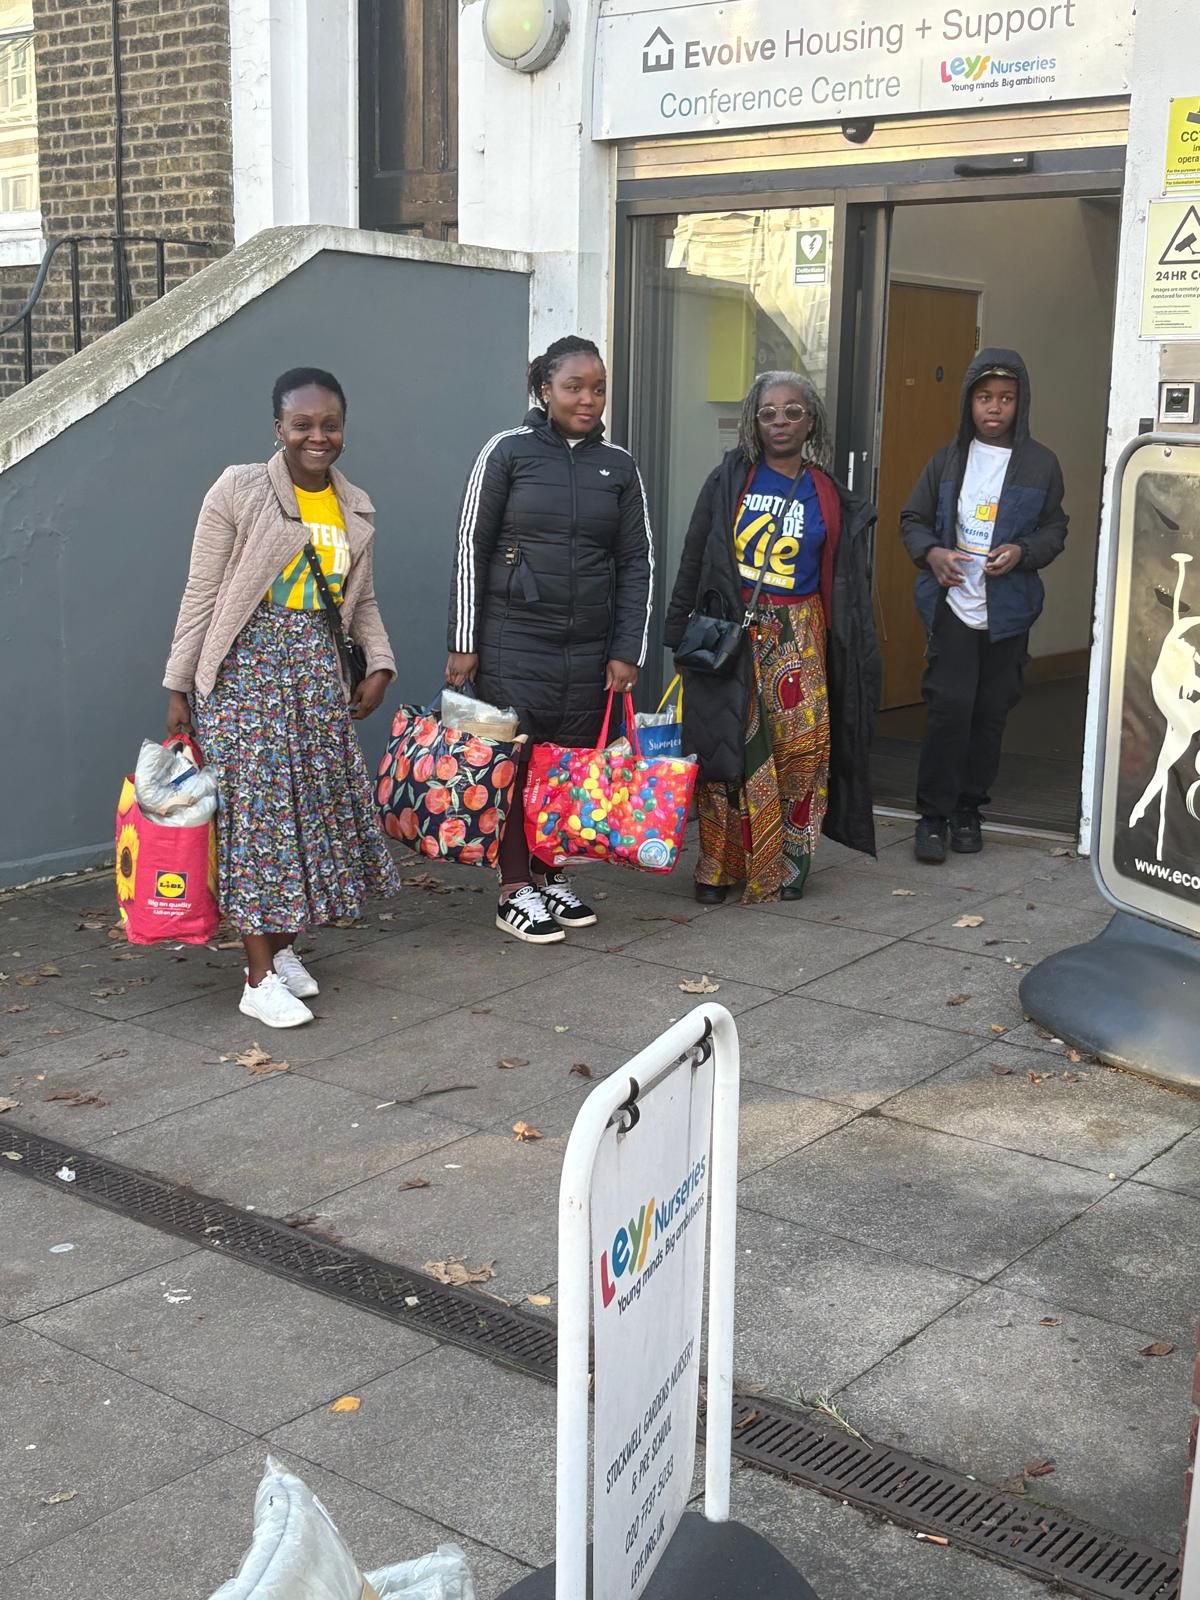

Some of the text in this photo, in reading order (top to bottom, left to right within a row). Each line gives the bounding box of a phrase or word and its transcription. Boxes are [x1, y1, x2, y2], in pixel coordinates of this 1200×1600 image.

[684, 0, 1076, 69] Evolve Housing + Support
[951, 75, 1056, 92] Young minds Big ambitions
[990, 57, 1057, 75] Nurseries
[660, 74, 901, 119] Conference Centre
[1180, 130, 1200, 142] CC
[1190, 269, 1200, 281] C
[733, 504, 800, 576] Vie
[781, 515, 804, 538] DE
[654, 1153, 706, 1241] Nurseries
[617, 1191, 705, 1316] Young minds Big ambitions
[606, 1335, 695, 1495] STOCKWELL GARDENS NURSERY
[631, 1410, 672, 1496] & PRE SCHOOL
[625, 1514, 640, 1555] 020
